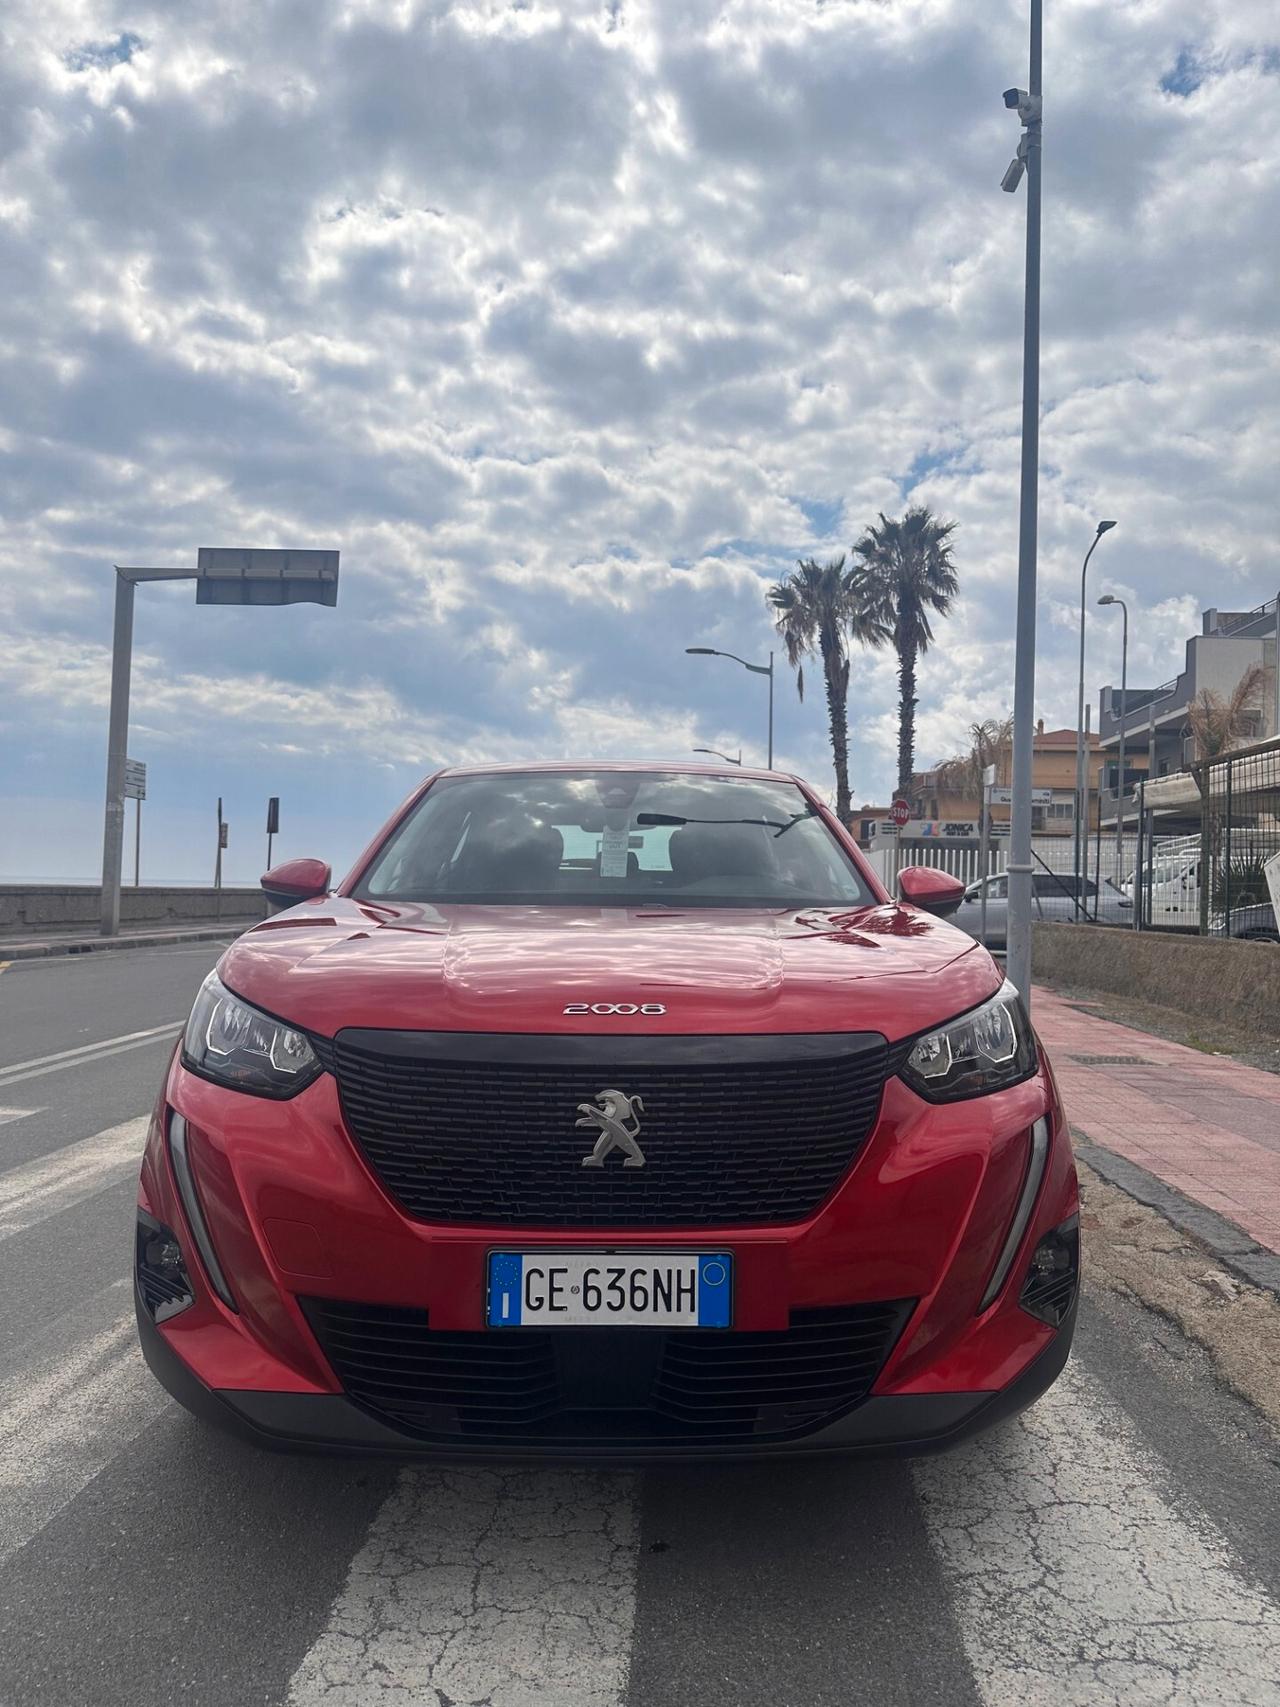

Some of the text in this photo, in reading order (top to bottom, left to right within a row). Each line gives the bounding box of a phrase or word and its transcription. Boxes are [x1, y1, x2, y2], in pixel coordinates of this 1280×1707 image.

[893, 808, 909, 819] STOP
[944, 823, 974, 832] JONICA
[562, 1003, 667, 1015] 2008
[525, 1268, 696, 1312] GE 636NH
[502, 1292, 509, 1318] I
